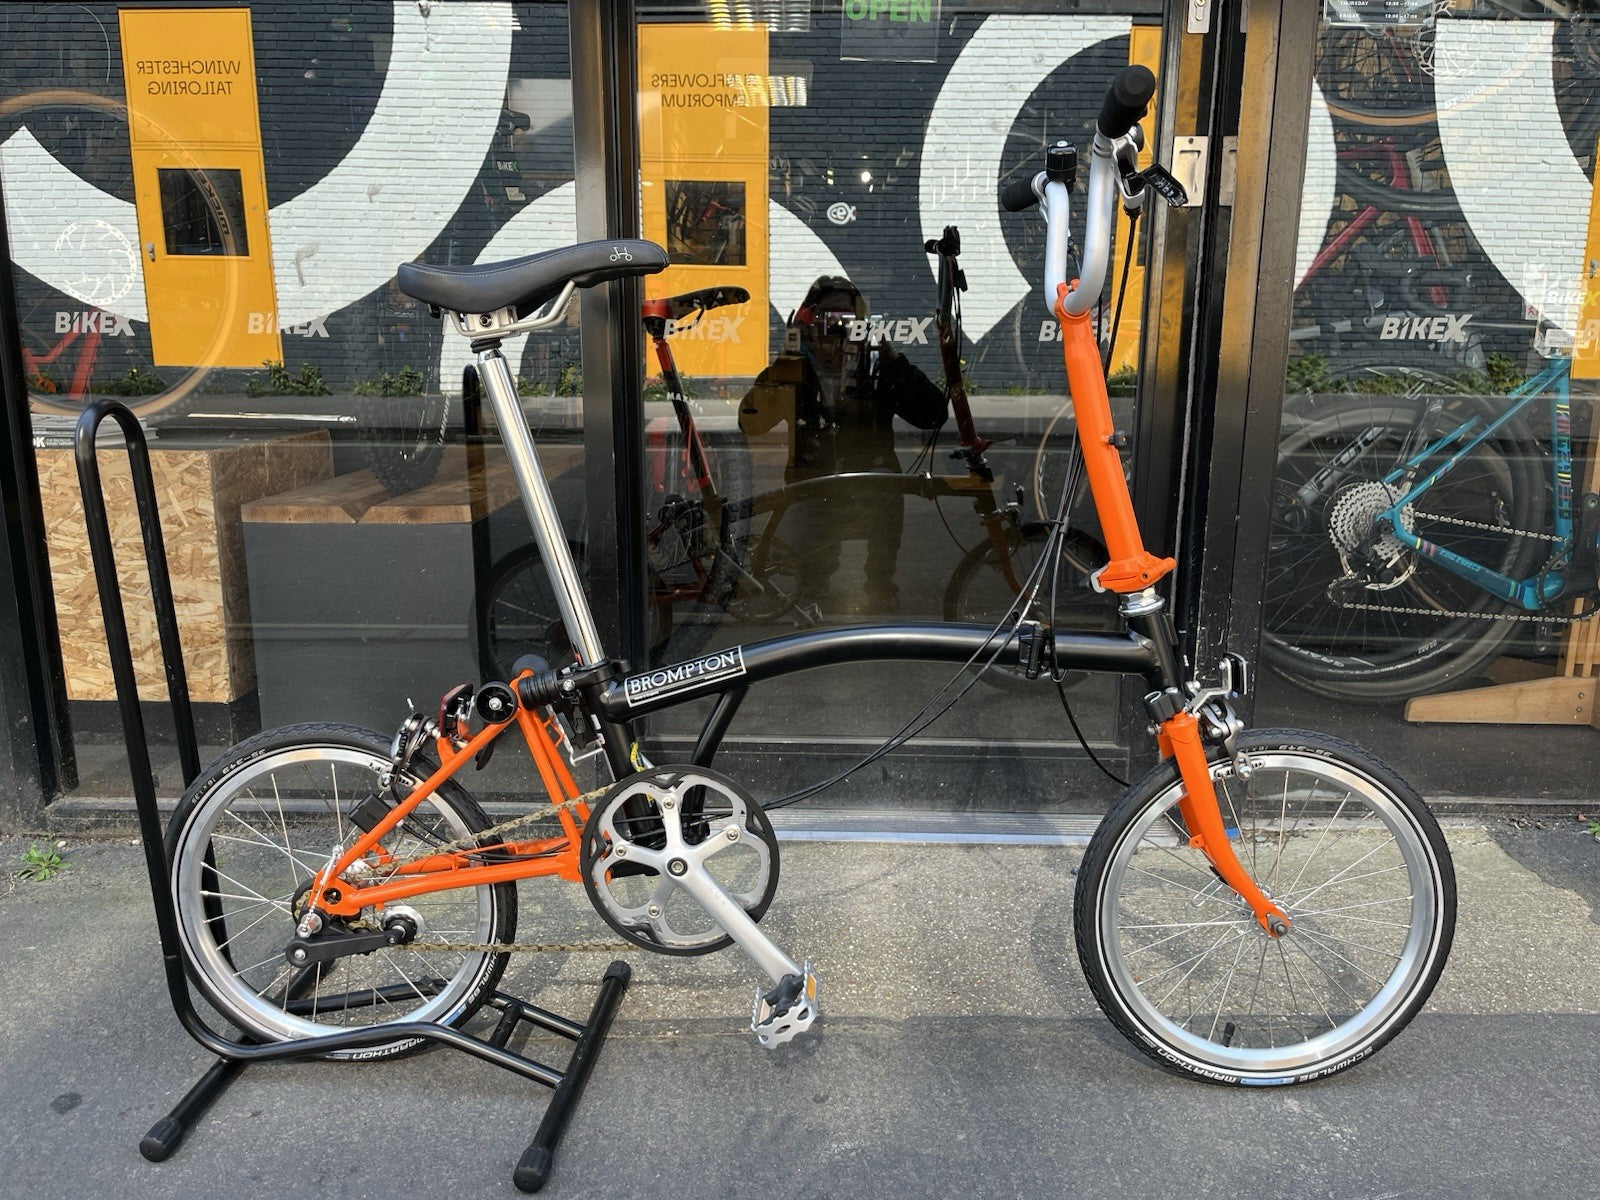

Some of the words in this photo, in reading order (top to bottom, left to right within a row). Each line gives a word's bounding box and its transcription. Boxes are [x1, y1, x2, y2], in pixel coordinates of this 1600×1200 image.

[845, 0, 931, 22] OPEN
[55, 311, 136, 337] BIKEX
[849, 317, 934, 345] BIKEX
[1380, 314, 1474, 343] BIKEX
[631, 651, 736, 694] BROMPTON
[1157, 1047, 1237, 1083] MARATHON
[1298, 1046, 1373, 1083] SCHWALBE
